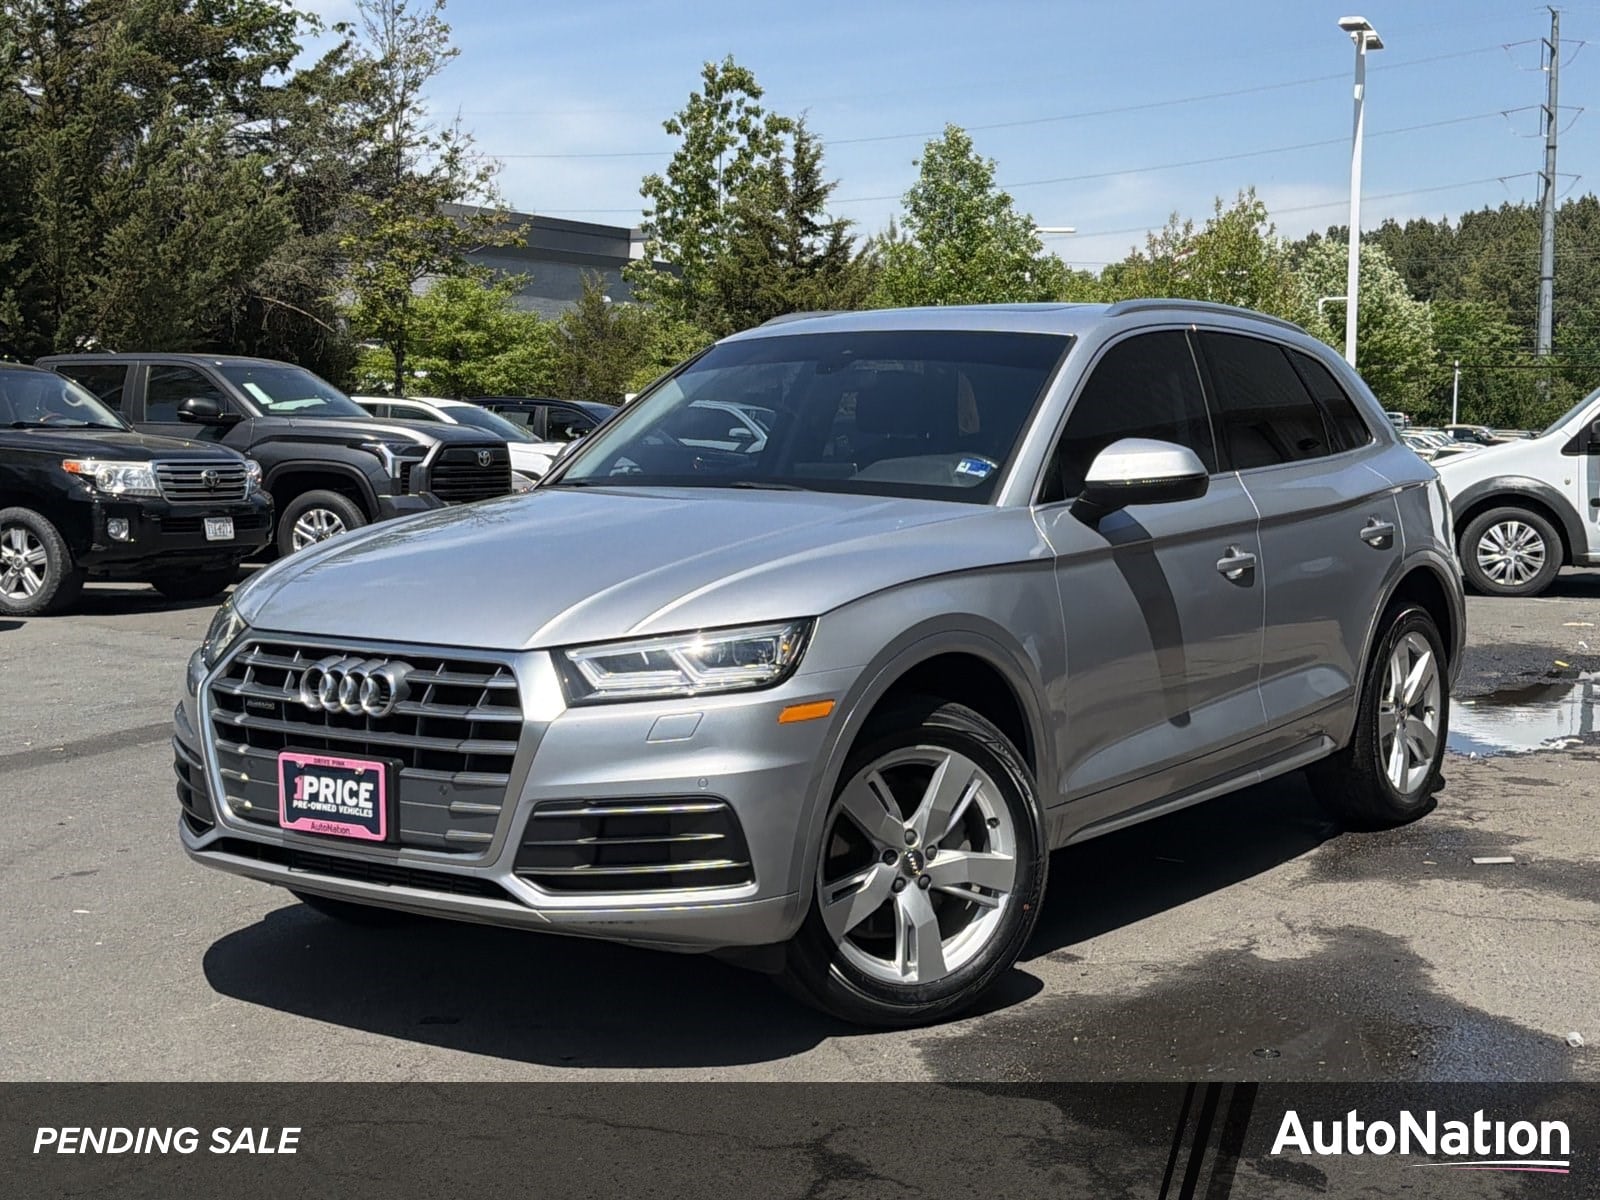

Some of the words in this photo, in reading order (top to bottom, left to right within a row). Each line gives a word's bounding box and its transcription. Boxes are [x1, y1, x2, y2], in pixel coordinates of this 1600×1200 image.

[292, 799, 337, 813] PRE-OWNED
[338, 805, 373, 818] VEHICLES
[310, 821, 351, 835] AutoNation
